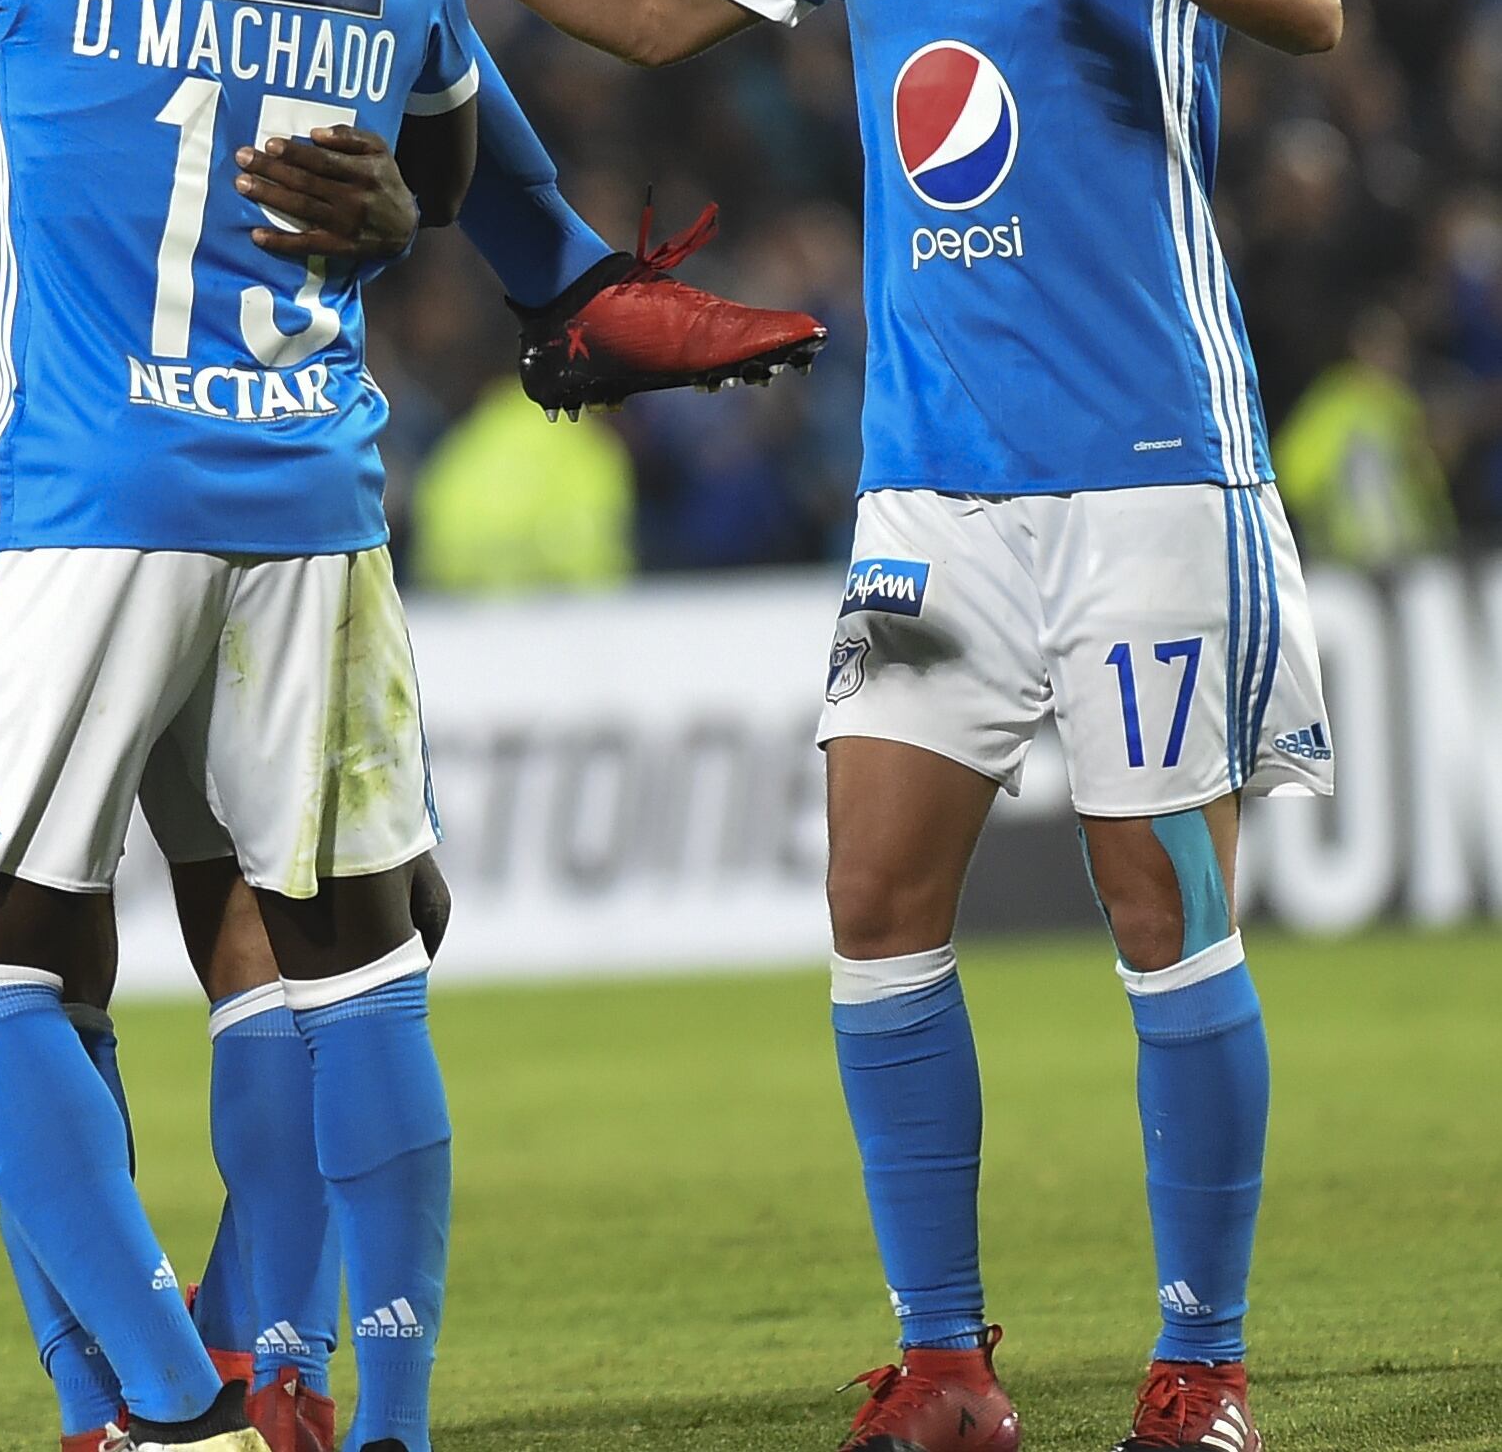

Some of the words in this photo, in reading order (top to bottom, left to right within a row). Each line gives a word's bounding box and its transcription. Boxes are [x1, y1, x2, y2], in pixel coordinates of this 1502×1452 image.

[912, 216, 1023, 270] pepsi
[127, 354, 338, 421] NECTAR
[1104, 635, 1204, 769] 17
[1274, 737, 1332, 761] adidas
[255, 1343, 310, 1355] adidas
[356, 1324, 424, 1339] adidas
